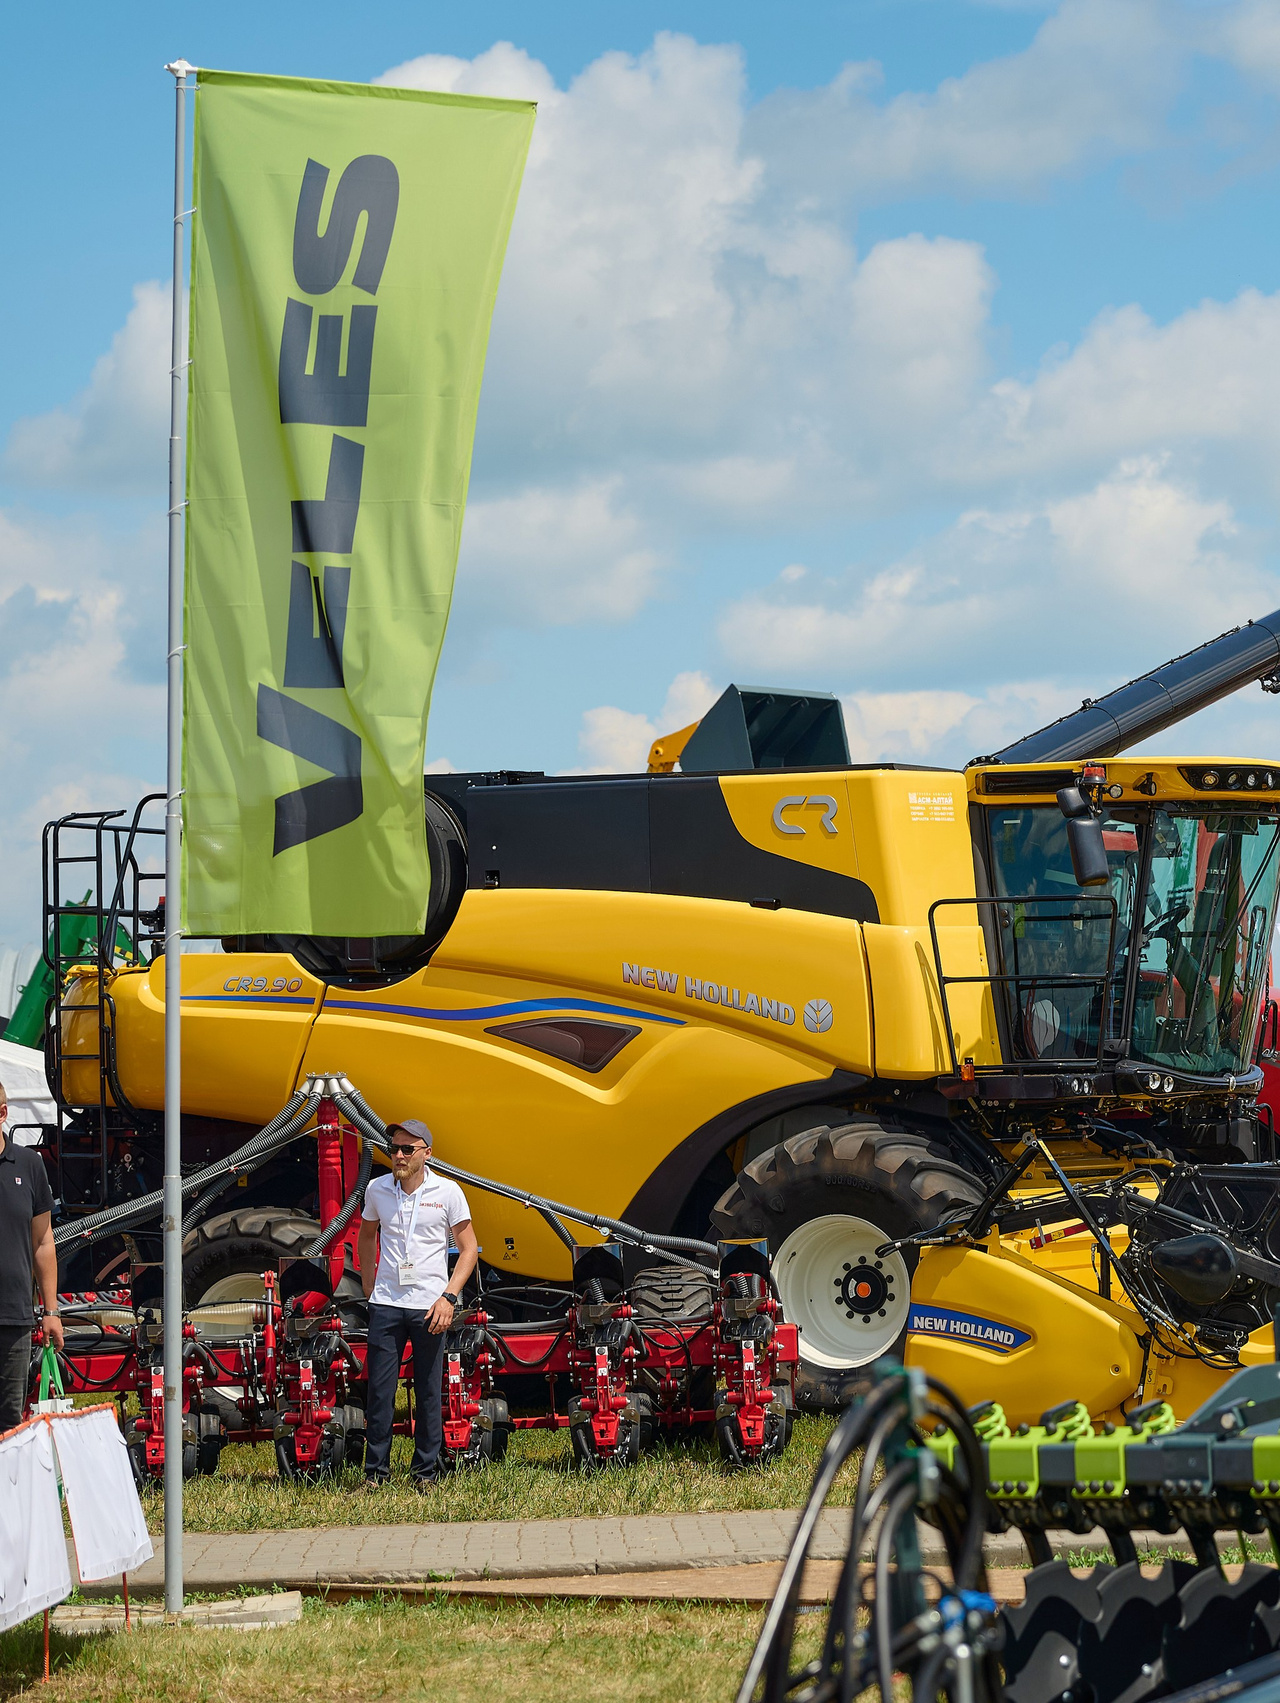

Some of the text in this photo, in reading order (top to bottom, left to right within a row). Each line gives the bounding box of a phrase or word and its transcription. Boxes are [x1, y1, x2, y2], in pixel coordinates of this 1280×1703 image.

[257, 154, 400, 857] VELES
[773, 794, 839, 835] CR
[223, 976, 303, 993] CR9.90
[622, 961, 796, 1026] NEW HOLLAND
[913, 1315, 1015, 1346] NEW HOLLAND
